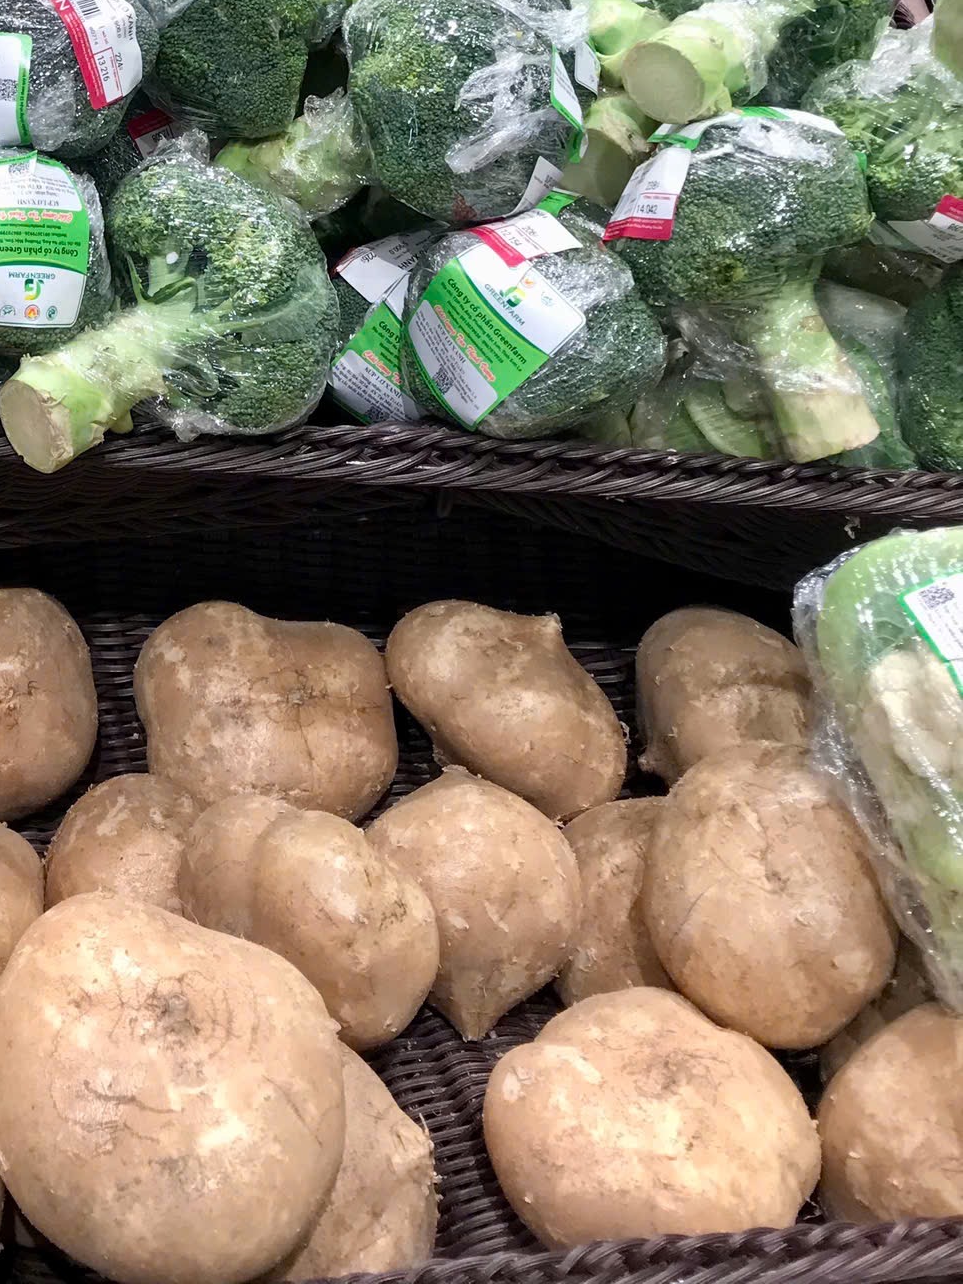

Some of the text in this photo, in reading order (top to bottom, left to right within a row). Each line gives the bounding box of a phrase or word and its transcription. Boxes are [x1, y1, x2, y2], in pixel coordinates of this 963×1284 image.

[24, 246, 42, 256] phần
[44, 248, 51, 256] cổ
[62, 248, 78, 257] Công
[444, 277, 530, 364] Công ty cổ phần Greenfarm
[376, 320, 397, 339] Công
